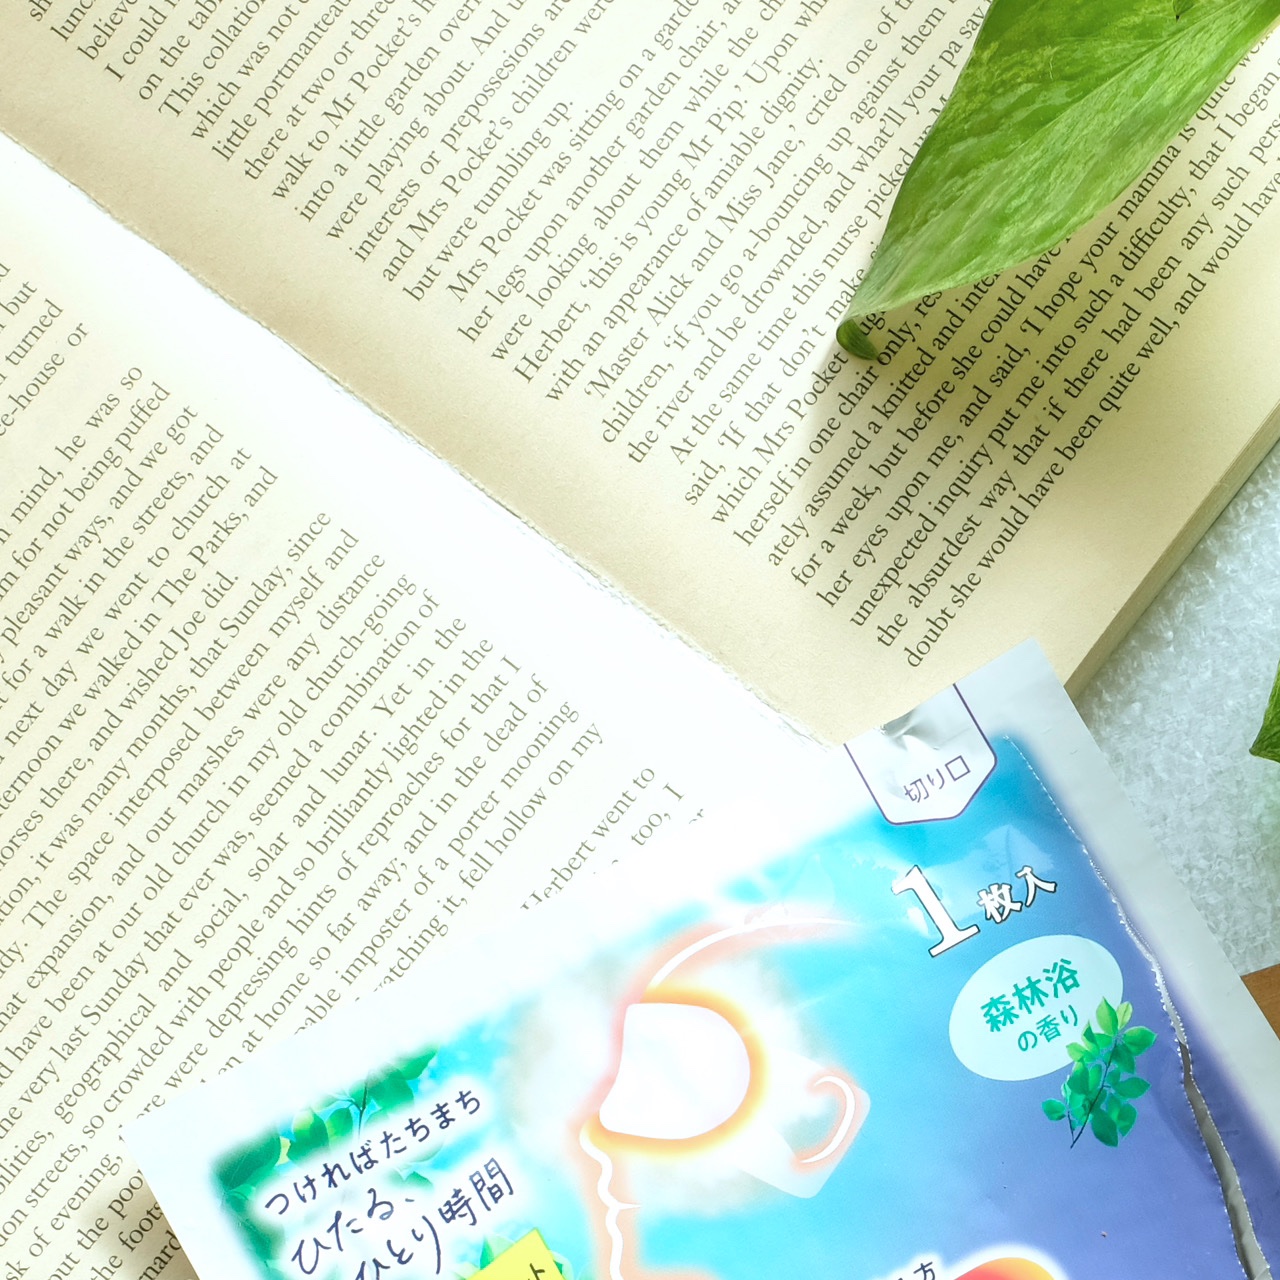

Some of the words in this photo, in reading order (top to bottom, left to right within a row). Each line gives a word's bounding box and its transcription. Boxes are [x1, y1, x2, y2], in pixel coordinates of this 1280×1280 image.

[271, 152, 314, 199] walk
[307, 130, 330, 152] to
[321, 92, 357, 130] Mr
[325, 192, 368, 239] were
[365, 117, 430, 195] playing
[423, 60, 475, 117] about.
[470, 8, 511, 56] And
[402, 264, 442, 302] but
[435, 216, 478, 263] were
[473, 127, 552, 215] tumbling
[542, 101, 573, 127] up.
[490, 313, 533, 360] were
[525, 233, 598, 310] looking
[593, 173, 642, 231] about
[639, 120, 685, 169] them
[682, 64, 730, 113] while
[727, 27, 759, 58] the
[545, 358, 586, 401] with
[582, 331, 607, 357] an
[603, 223, 689, 330] appearance
[686, 191, 707, 222] of
[704, 126, 766, 200] amiable
[760, 57, 823, 125] dignity.
[601, 362, 675, 443] children,
[686, 292, 722, 336] you
[719, 264, 744, 295] go
[742, 153, 834, 262] a-bouncing
[825, 126, 854, 152] up
[850, 56, 907, 125] against
[900, 7, 947, 56] them
[10, 465, 65, 524] mind,
[54, 435, 86, 462] he
[84, 393, 121, 429] was
[120, 367, 143, 391] so
[669, 435, 698, 465] At
[690, 403, 723, 436] the
[719, 352, 762, 404] same
[757, 307, 797, 351] time
[791, 268, 827, 306] this
[822, 215, 868, 270] nurse
[863, 146, 914, 220] picked
[815, 569, 854, 608] her
[852, 524, 889, 568] eyes
[884, 471, 931, 521] upon
[926, 434, 964, 469] me,
[959, 384, 993, 428] and
[988, 342, 1031, 388] said,
[1033, 271, 1083, 321] hope
[1079, 221, 1120, 274] your
[1116, 145, 1182, 222] mamma
[903, 606, 957, 668] doubt
[949, 572, 982, 609] she
[976, 504, 1030, 569] would
[1017, 462, 1065, 510] have
[1053, 414, 1103, 462] been
[1098, 362, 1141, 413] quite
[1135, 316, 1181, 360] well,
[1174, 272, 1207, 315] and
[1200, 212, 1253, 274] would
[0, 562, 69, 648] pleasant
[63, 514, 115, 561] ways,
[109, 466, 144, 510] and
[138, 441, 168, 469] we
[166, 405, 198, 446] got
[4, 700, 45, 748] next
[41, 659, 78, 698] day
[75, 627, 105, 655] we
[104, 571, 150, 620] went
[147, 546, 170, 568] to
[171, 475, 231, 541] church
[230, 447, 252, 470] at
[4, 1015, 53, 1063] have
[43, 966, 96, 1013] been
[92, 940, 115, 964] at
[111, 901, 143, 939] our
[143, 862, 174, 901] old
[171, 799, 232, 866] church
[222, 775, 251, 798] in
[247, 737, 280, 774] my
[277, 698, 308, 737] old
[305, 574, 417, 701] church-going
[21, 889, 68, 930] The
[67, 831, 115, 886] space
[108, 721, 201, 828] interposed
[193, 642, 271, 722] between
[268, 565, 325, 639] myself
[324, 528, 360, 571] and
[54, 992, 157, 1125] geographical
[158, 948, 193, 993] and
[193, 887, 250, 949] social,
[247, 831, 290, 882] solar
[292, 784, 327, 828] and
[319, 729, 378, 785] lunar.
[370, 682, 413, 718] Yet
[406, 657, 436, 680] in
[434, 618, 467, 650] the
[241, 1029, 264, 1053] at
[253, 972, 310, 1030] home
[309, 946, 331, 971] so
[326, 912, 357, 944] far
[357, 857, 408, 912] away;
[403, 810, 438, 855] and
[430, 792, 458, 814] in
[454, 755, 487, 788] the
[483, 701, 528, 752] dead
[526, 672, 548, 703] of
[335, 898, 413, 986] imposter
[413, 864, 436, 896] of
[434, 857, 450, 871] a
[447, 790, 500, 859] porter
[500, 701, 579, 790] mooning
[630, 812, 671, 846] too,
[662, 783, 684, 801] I
[904, 755, 971, 803] 切り口
[980, 958, 1081, 1033] 森林浴
[1017, 1004, 1080, 1052] の香り
[265, 1089, 481, 1215] つければたちまち
